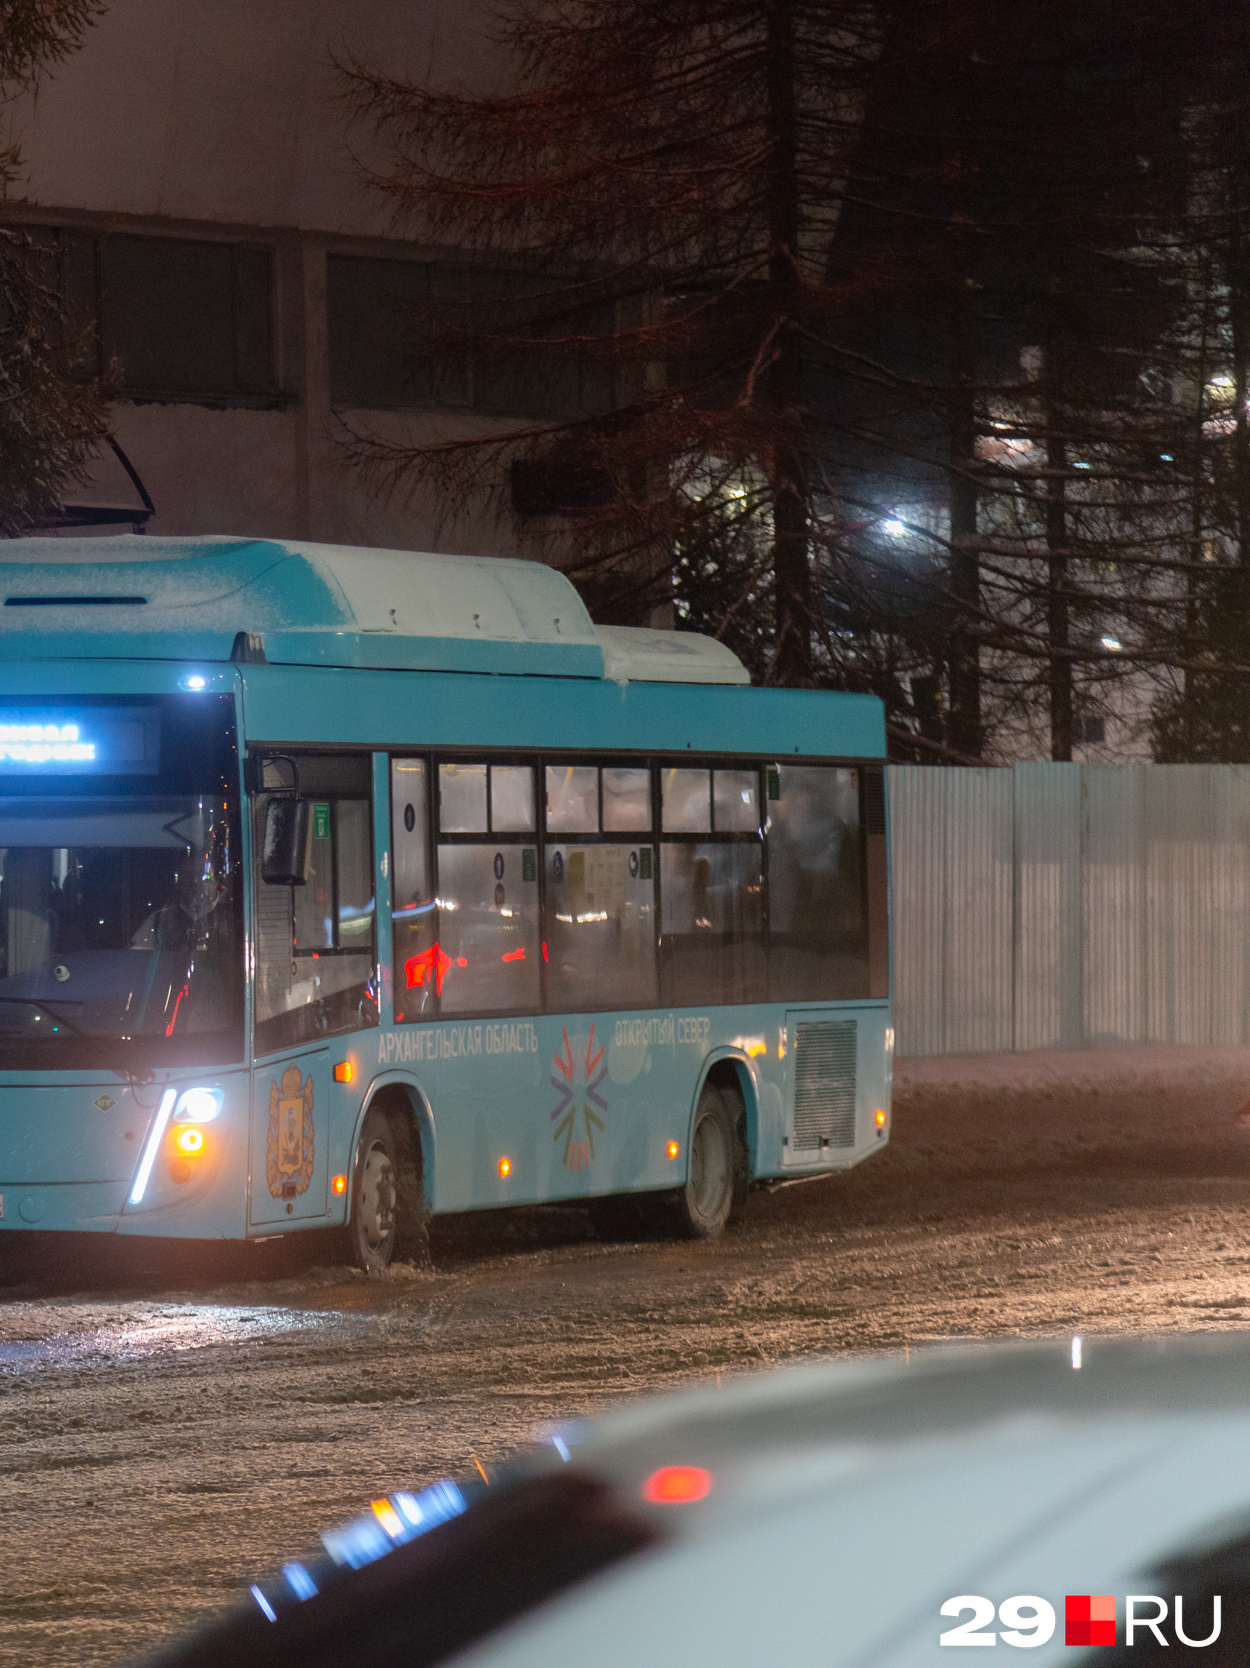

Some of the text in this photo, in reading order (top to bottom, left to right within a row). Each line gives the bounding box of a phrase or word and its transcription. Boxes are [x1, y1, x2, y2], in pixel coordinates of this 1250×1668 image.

[377, 1023, 538, 1064] АРХАНГЕЛЬСКАЯ ОБЛАСТЬ
[615, 1013, 710, 1047] ОТКРЫТЫЙ СЕВЕР
